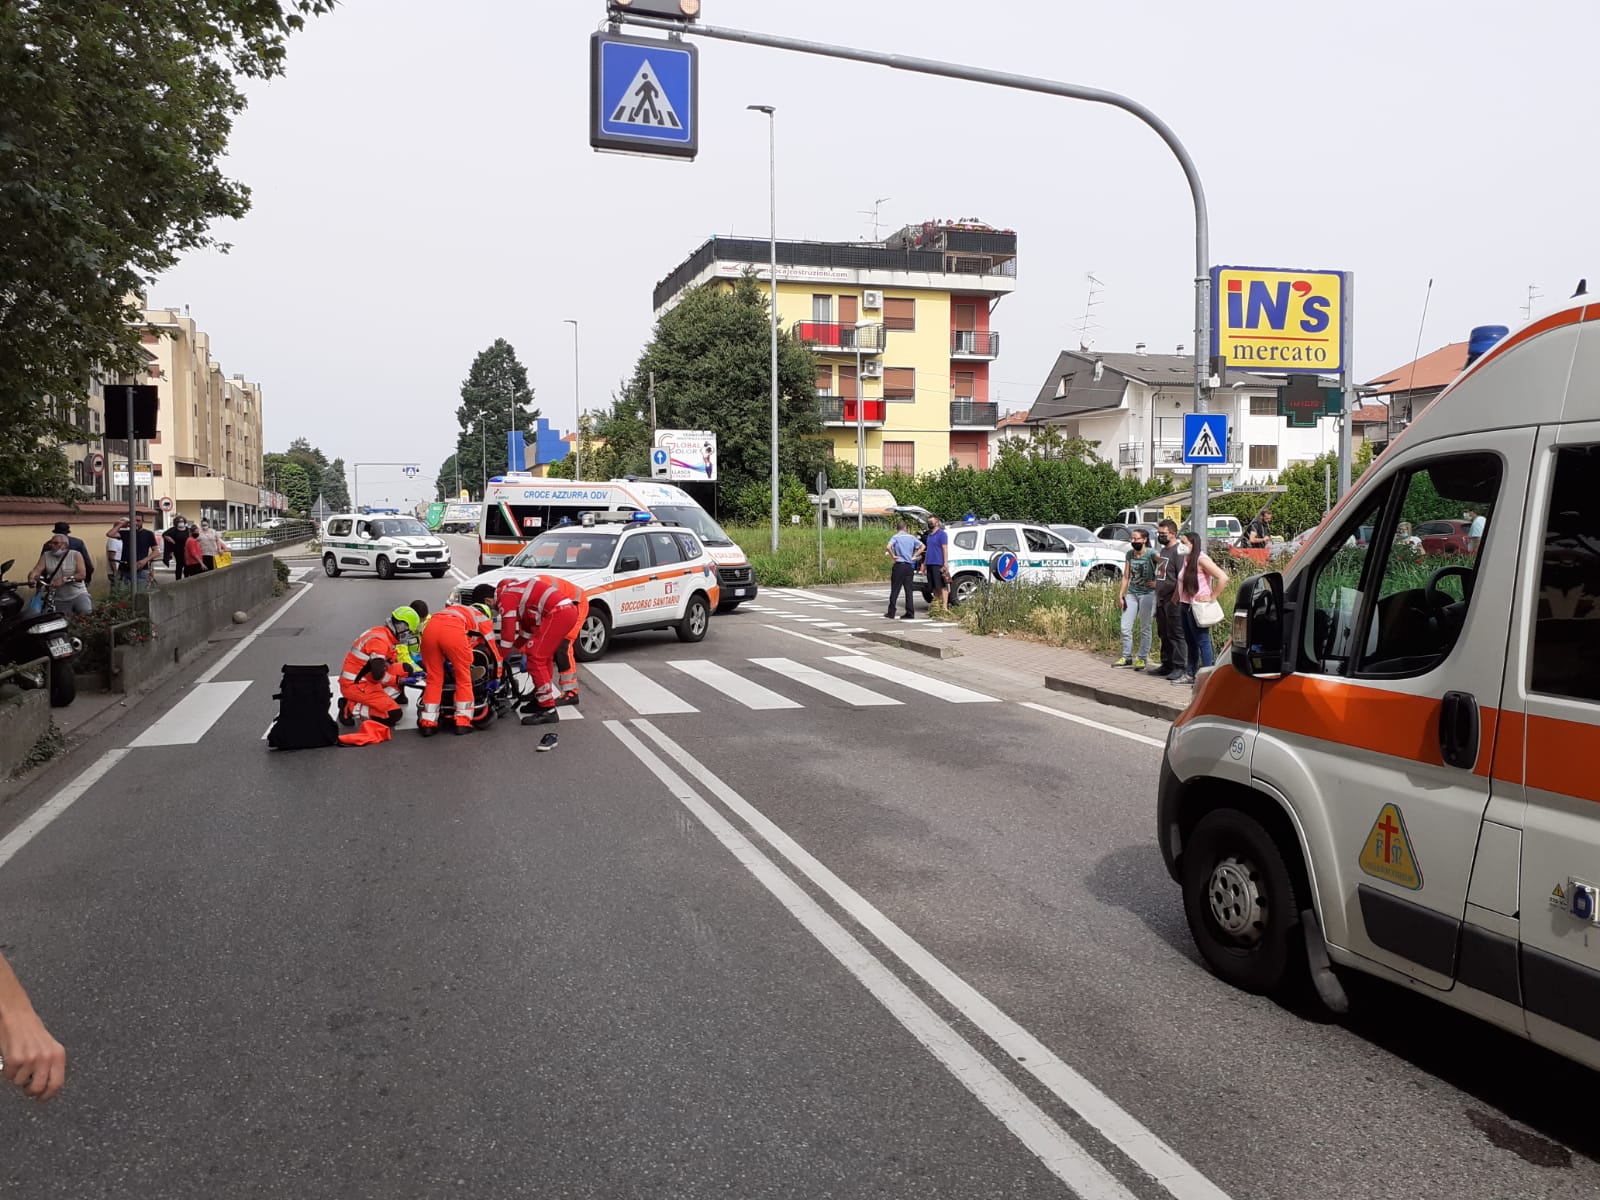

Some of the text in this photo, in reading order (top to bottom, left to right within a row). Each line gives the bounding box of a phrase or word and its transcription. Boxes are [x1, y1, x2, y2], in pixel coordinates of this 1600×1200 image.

[1233, 344, 1327, 362] mercato
[523, 490, 608, 500] CROCE AZZURRA ODV
[620, 594, 681, 612] SOCCORSO SANITARIO
[1232, 741, 1243, 754] 59
